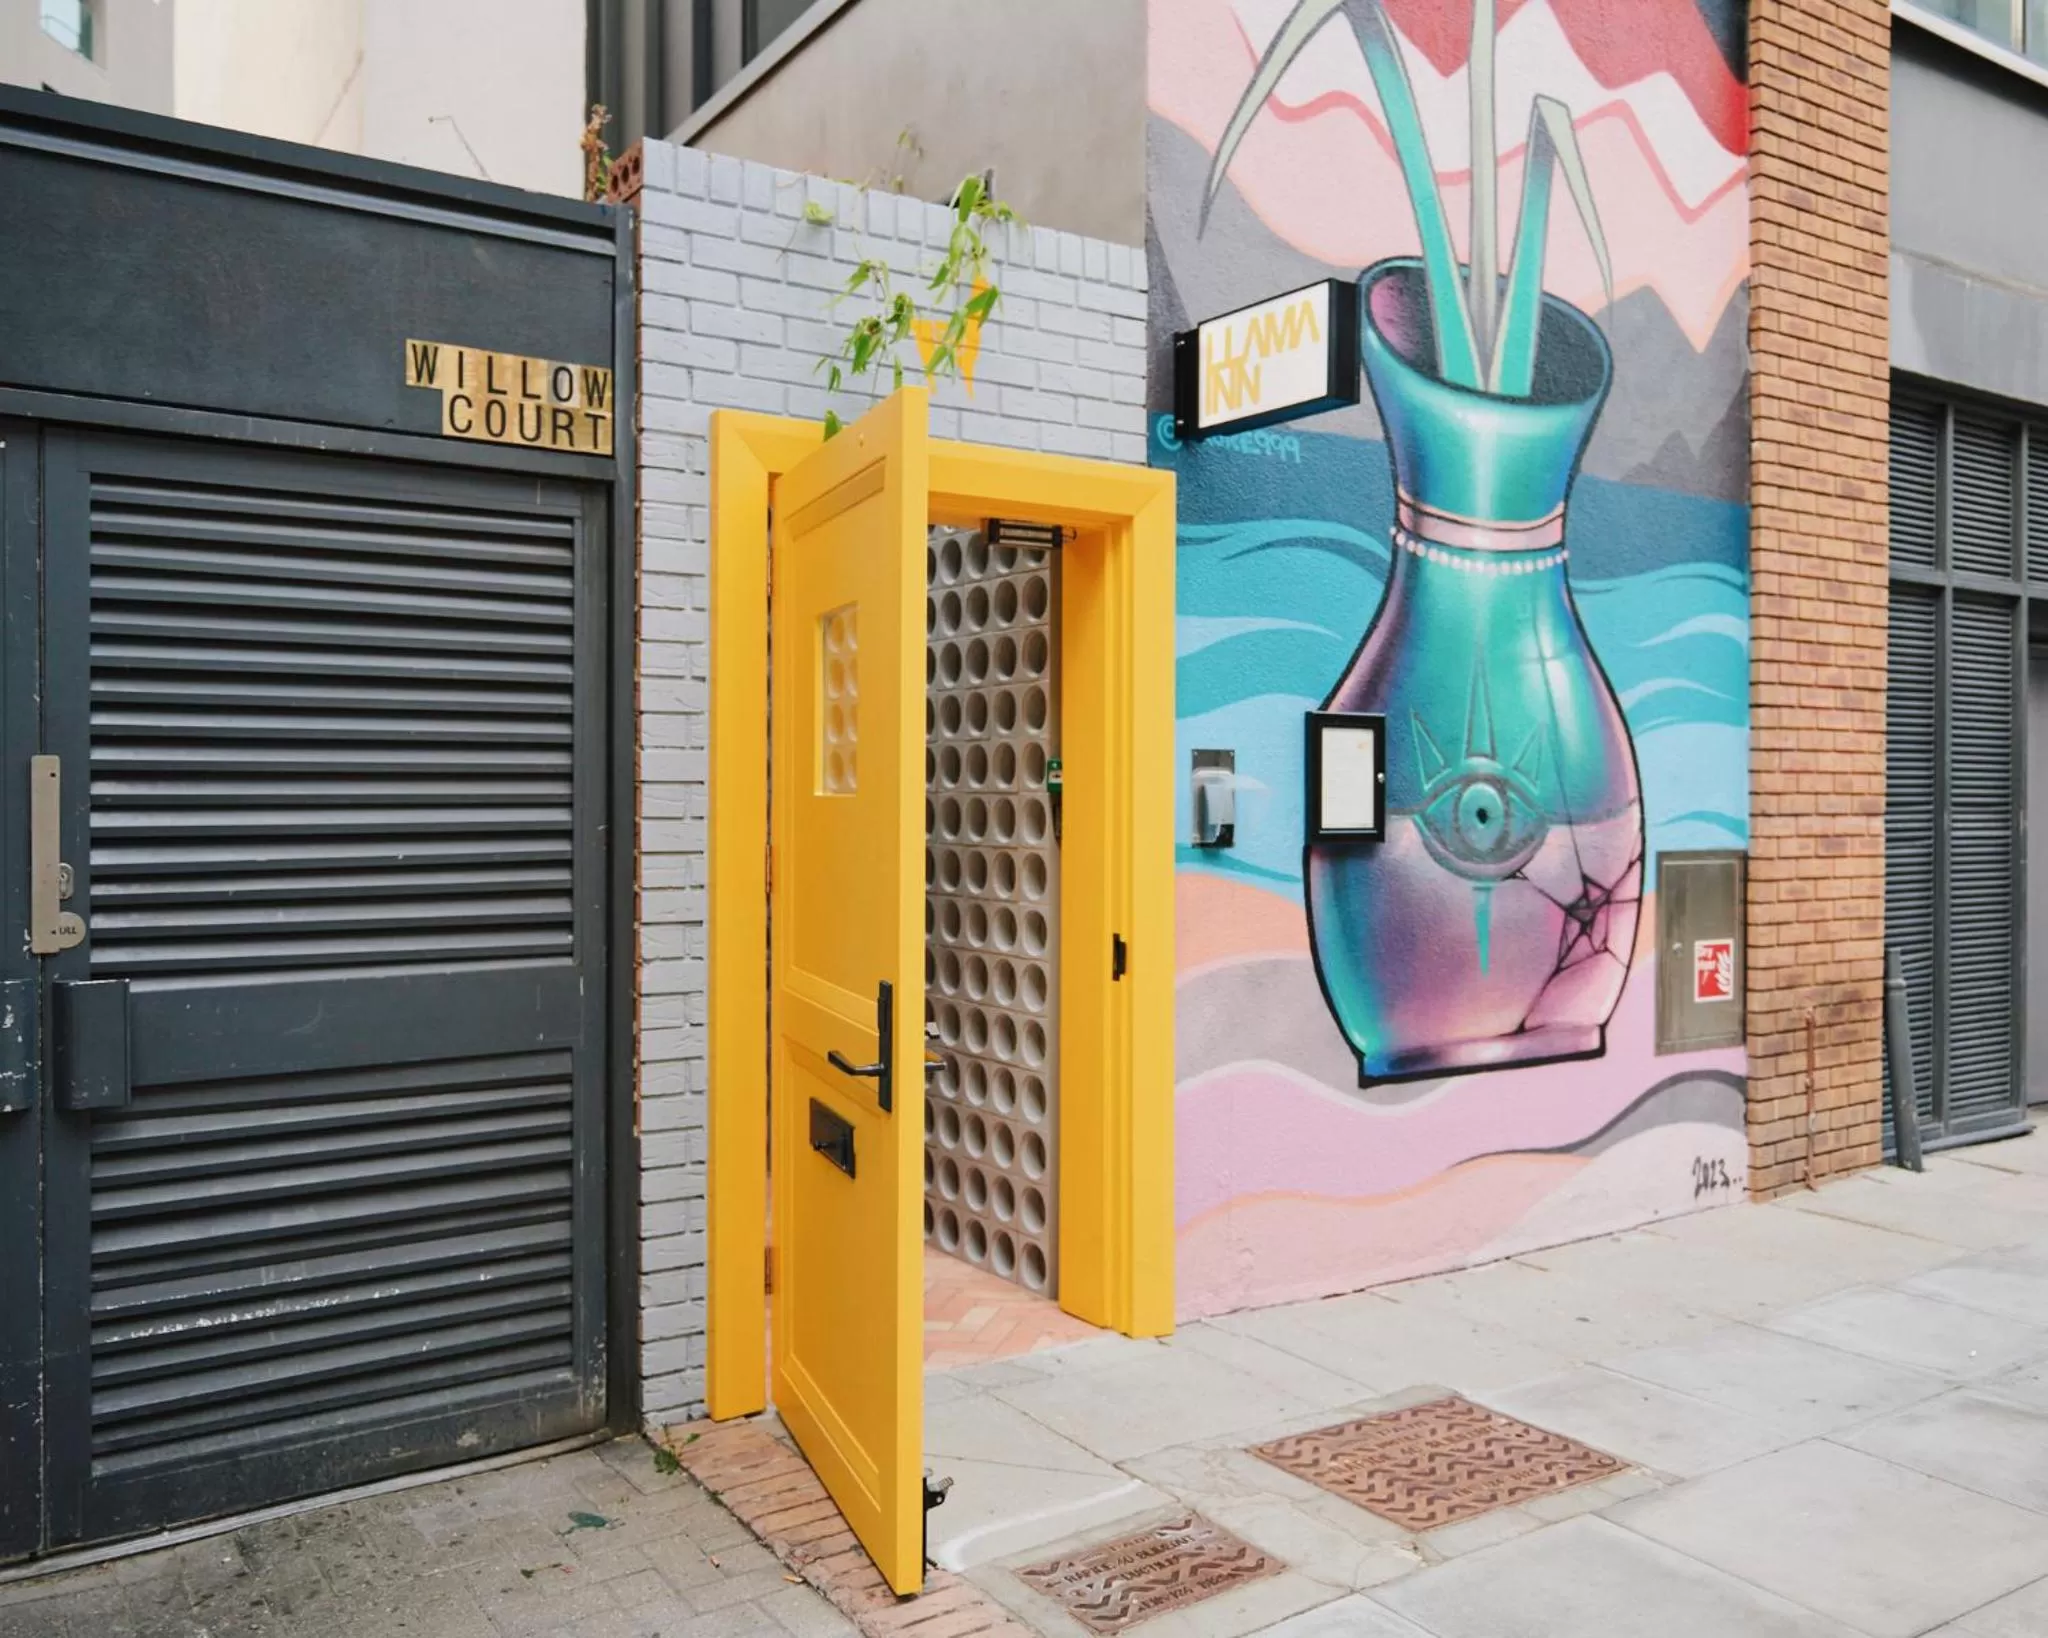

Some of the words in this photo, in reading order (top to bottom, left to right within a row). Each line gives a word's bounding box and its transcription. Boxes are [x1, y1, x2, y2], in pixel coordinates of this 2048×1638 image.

[1206, 300, 1321, 371] LLAMA
[411, 343, 608, 409] WILLOW
[1205, 358, 1262, 417] INN
[449, 394, 607, 450] COURT
